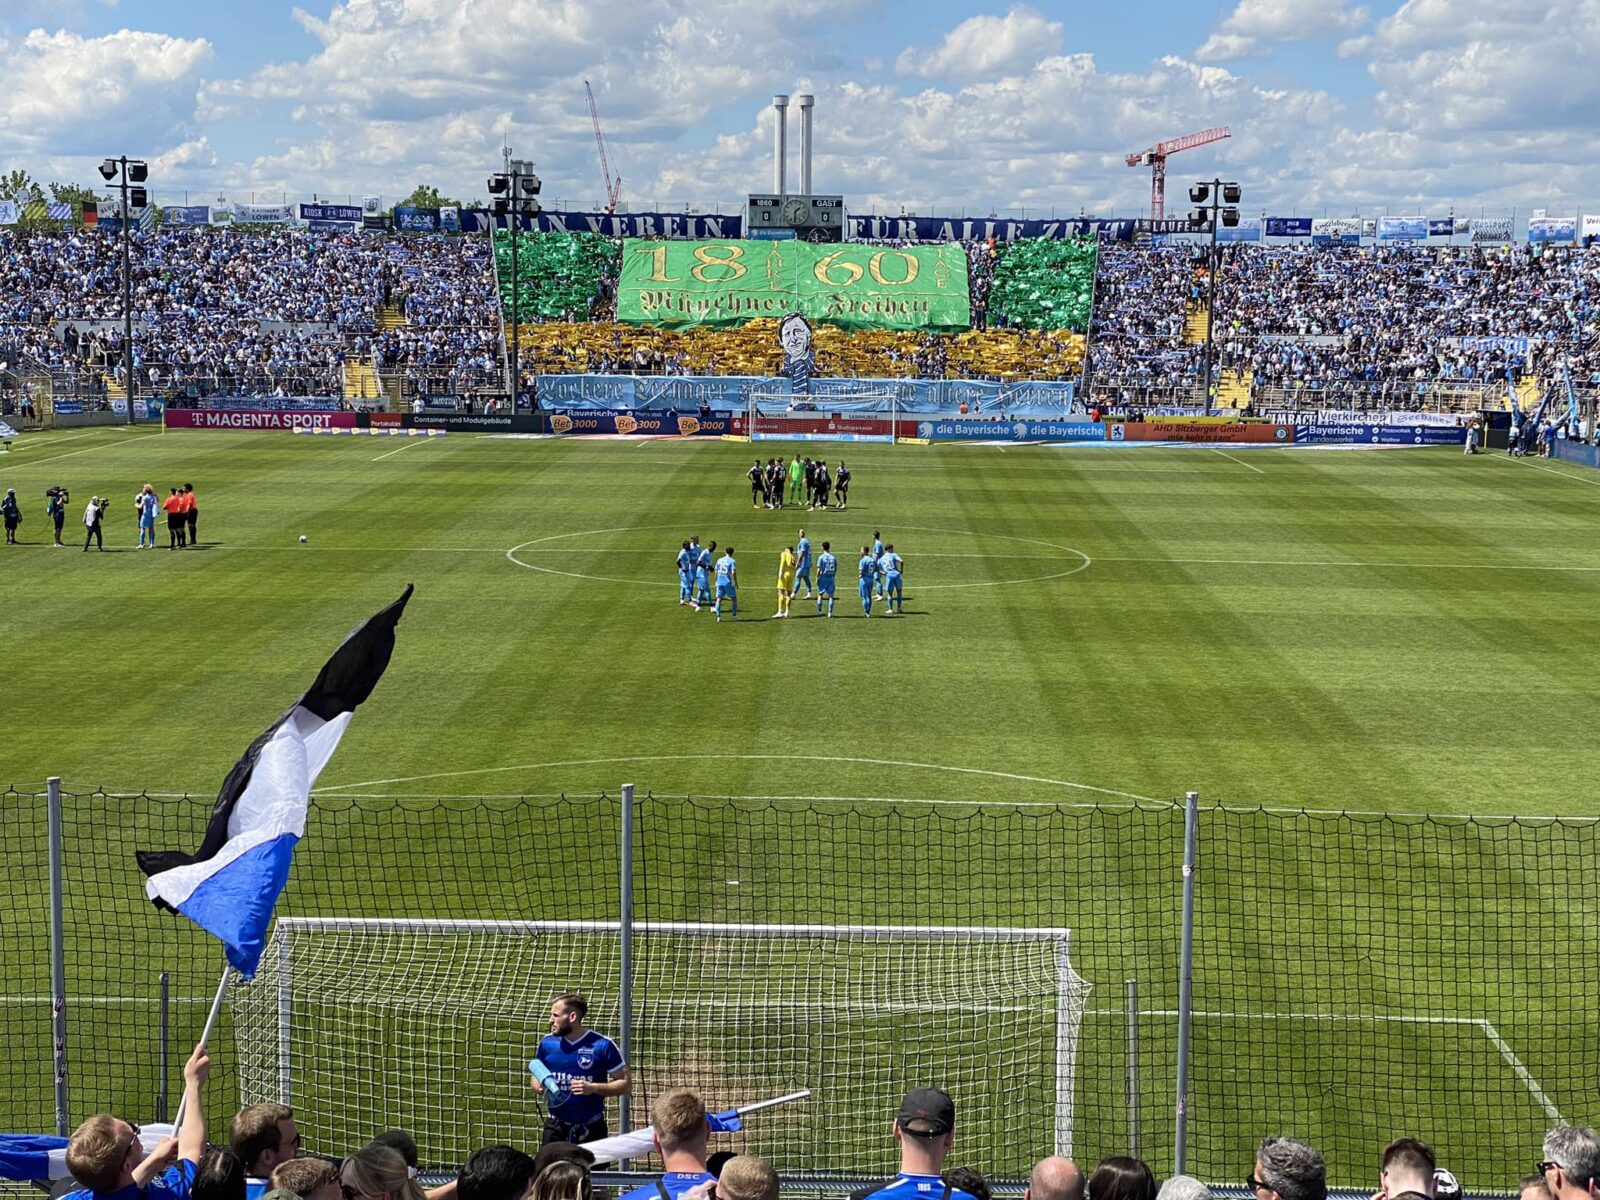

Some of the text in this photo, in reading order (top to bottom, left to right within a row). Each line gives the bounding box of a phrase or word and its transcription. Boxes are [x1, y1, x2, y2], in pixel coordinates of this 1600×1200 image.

[304, 208, 362, 219] KIOSK LÖWEN
[584, 215, 725, 241] VEREIN
[848, 215, 919, 240] FÜR
[936, 220, 1026, 242] ALLE
[813, 250, 921, 287] 60
[827, 294, 931, 317] Freiheit
[207, 413, 282, 427] MAGENTA
[283, 414, 332, 428] SPORT
[413, 416, 512, 426] Container- und Modulgebäude
[1320, 409, 1387, 423] Vierkirchen
[936, 424, 1010, 437] die Bayerische
[1030, 425, 1104, 438] die Bayerische
[1175, 425, 1218, 434] Sitzberger
[1220, 425, 1247, 433] GmbH
[1308, 425, 1364, 436] Bayerische
